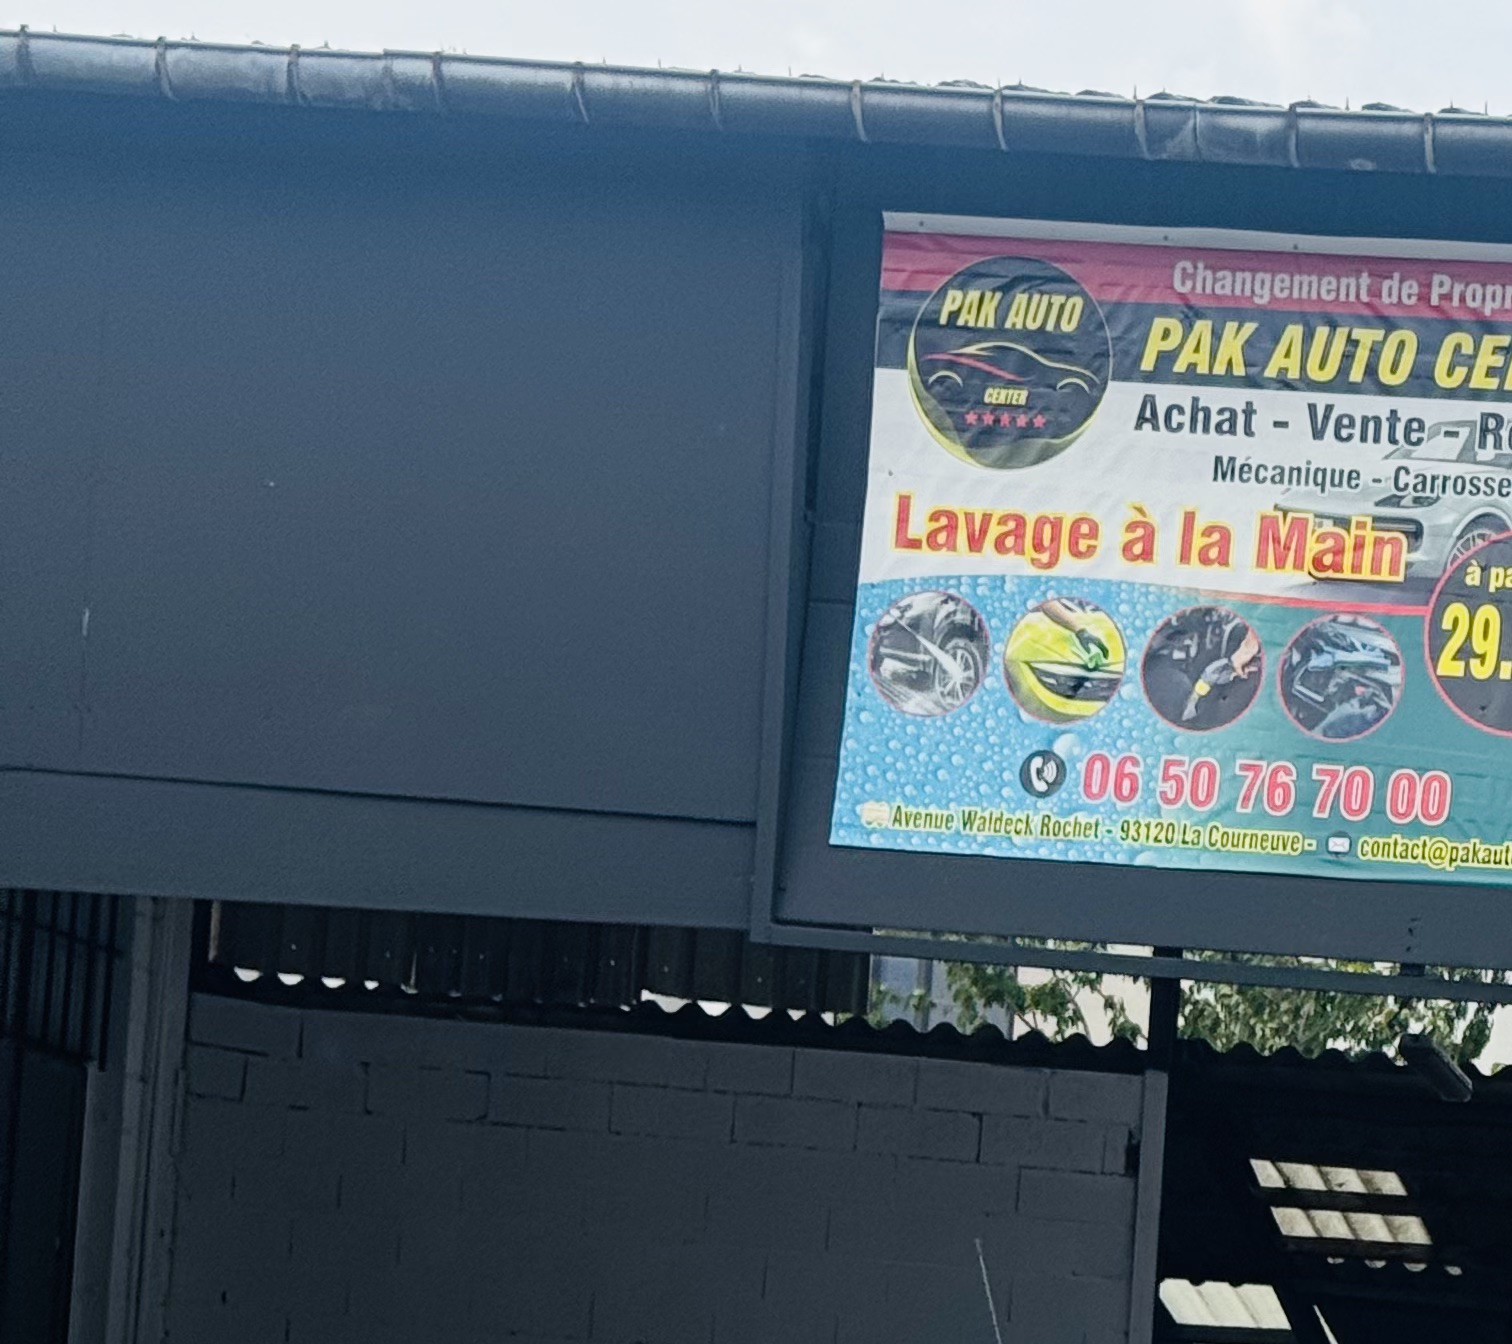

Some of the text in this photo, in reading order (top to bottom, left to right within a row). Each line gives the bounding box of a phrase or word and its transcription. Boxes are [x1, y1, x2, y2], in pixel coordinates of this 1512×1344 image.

[1173, 260, 1371, 304] Changement
[1381, 272, 1419, 304] de
[939, 289, 1084, 333] PAK AUTO
[1139, 316, 1259, 377] PAK
[1263, 324, 1419, 387] AUTO
[983, 386, 1028, 406] CENTER
[1134, 394, 1257, 437] Achat
[1307, 402, 1426, 447] Vente
[1212, 455, 1361, 494] Mécanique
[894, 494, 1406, 577] Lavage à la Main
[1465, 559, 1483, 587] à
[1082, 752, 1452, 826] 06 50 76 70 00
[892, 805, 954, 830] Avenue
[961, 809, 1034, 836] Waldeck
[1040, 814, 1100, 839] Rochet
[1119, 819, 1175, 845] 93120
[1181, 823, 1202, 847] La
[1208, 825, 1300, 852] Courneuve
